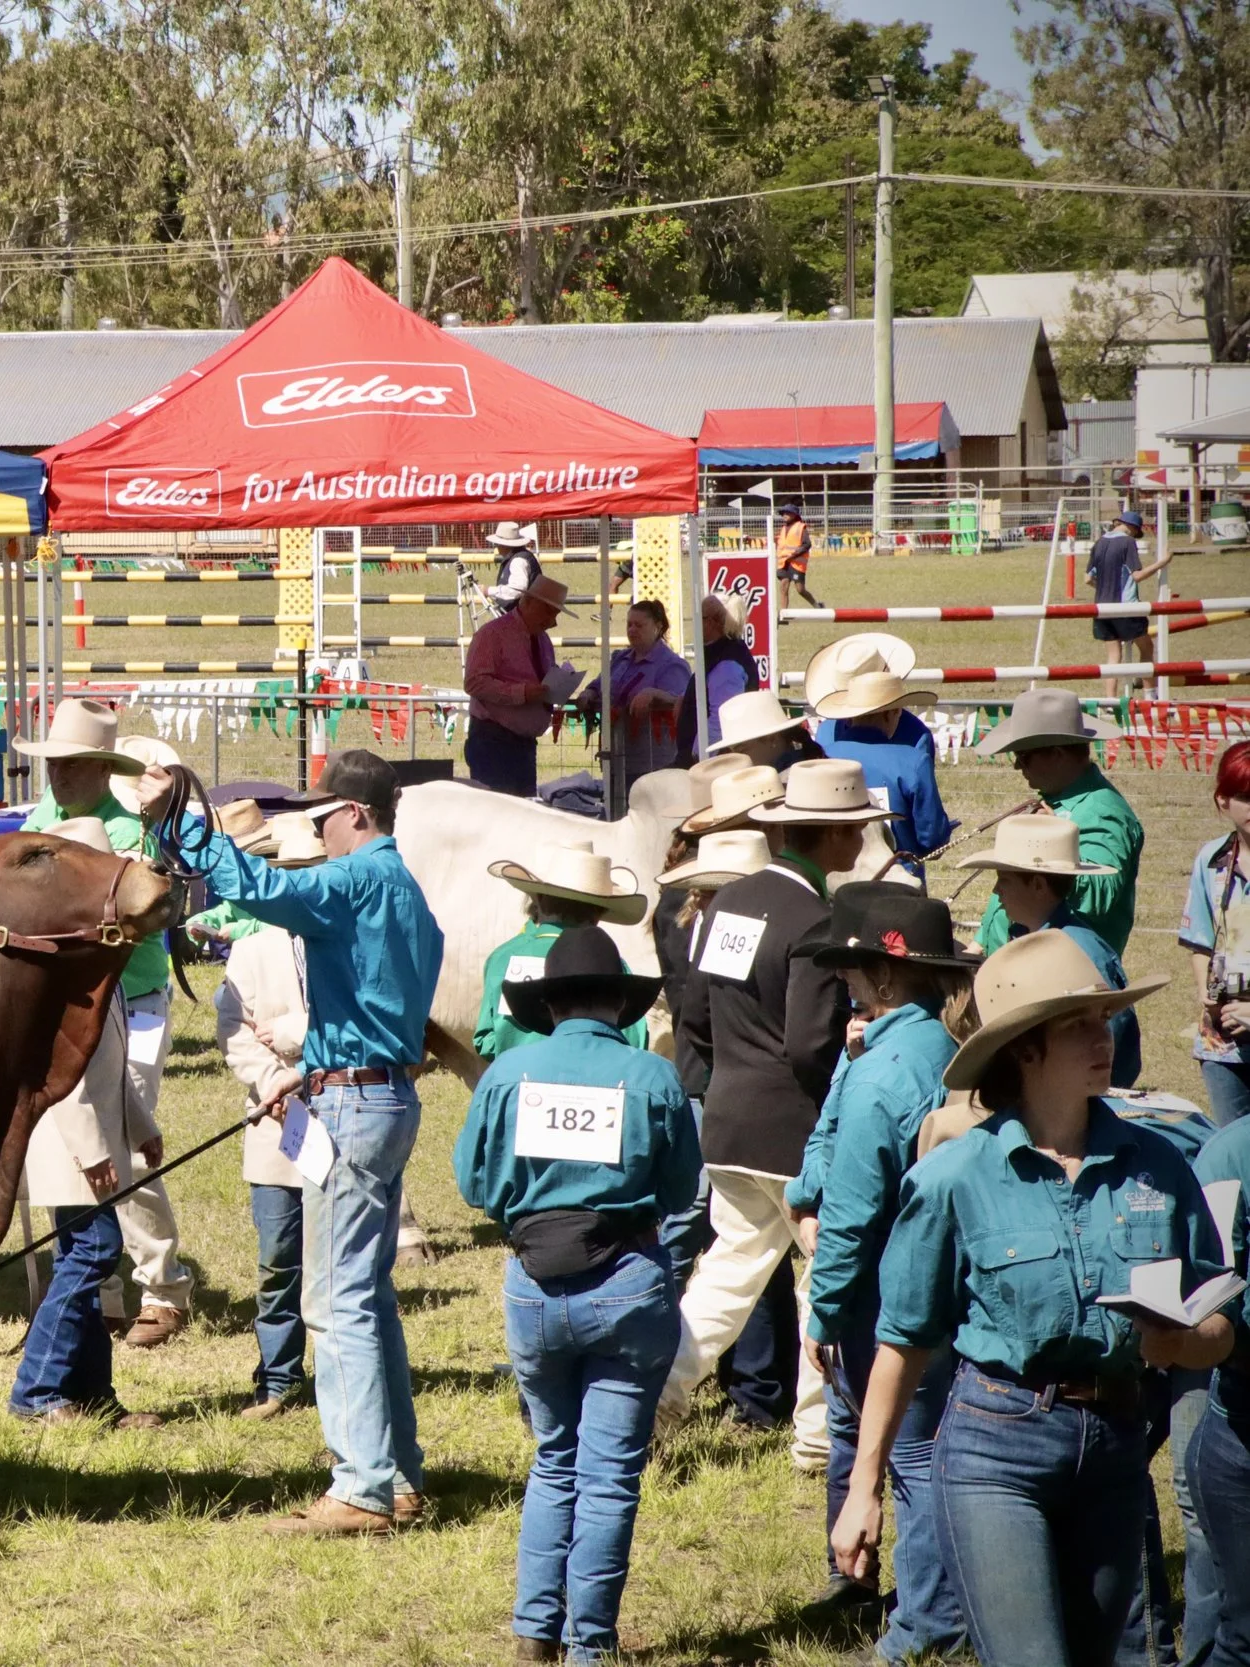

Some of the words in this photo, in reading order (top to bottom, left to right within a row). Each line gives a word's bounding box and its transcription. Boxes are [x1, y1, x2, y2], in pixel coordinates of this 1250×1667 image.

[261, 374, 453, 415] Elders
[115, 477, 213, 506] Elders
[240, 472, 295, 512] for
[291, 465, 457, 502] Australian
[464, 461, 639, 504] agriculture
[720, 932, 747, 954] 049
[545, 1106, 596, 1133] 182
